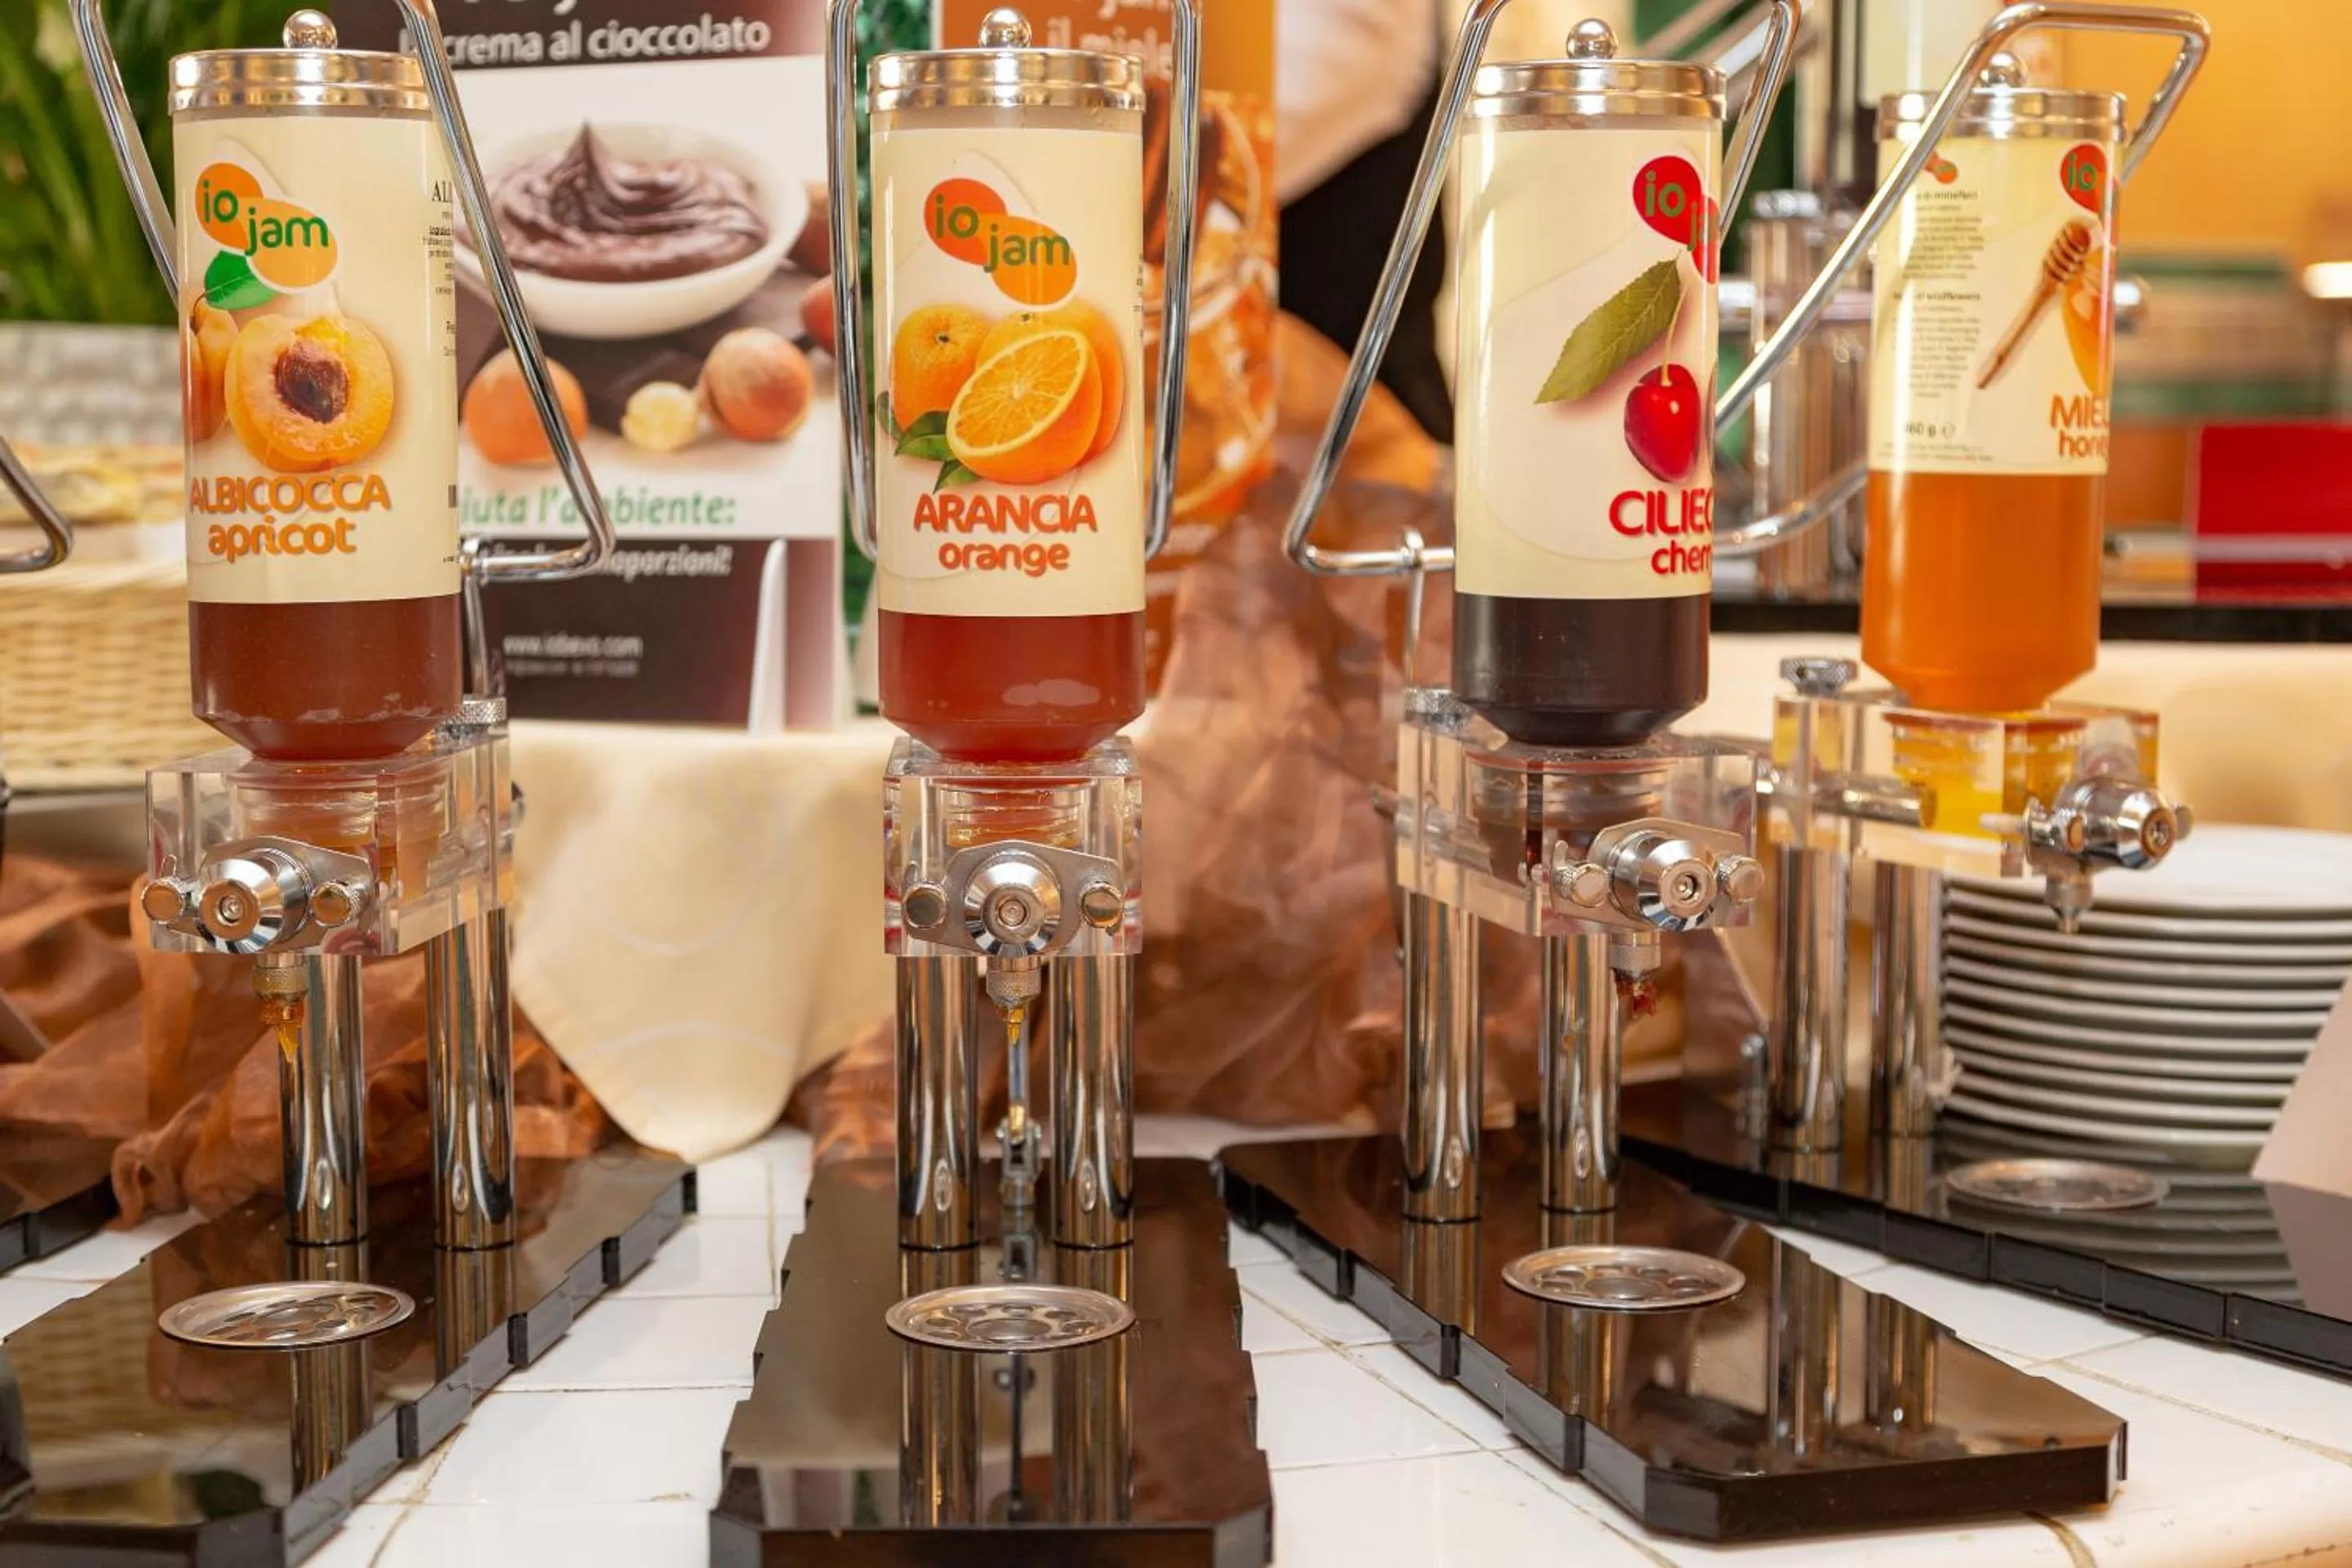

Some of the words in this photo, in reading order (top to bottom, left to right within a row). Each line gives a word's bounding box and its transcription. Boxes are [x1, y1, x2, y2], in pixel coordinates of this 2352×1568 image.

[443, 31, 544, 65] crema
[549, 20, 581, 61] al
[587, 13, 772, 60] cioccolato
[1645, 169, 1686, 218] io
[2068, 153, 2097, 190] io
[203, 179, 239, 223] io
[244, 207, 329, 257] jam
[935, 193, 980, 239] io
[982, 222, 1071, 273] jam
[189, 474, 392, 514] ALBICOCCA
[461, 487, 526, 524] iuta
[913, 492, 1098, 533] ARANCIA
[207, 514, 357, 564] apricot
[938, 541, 1071, 578] orange
